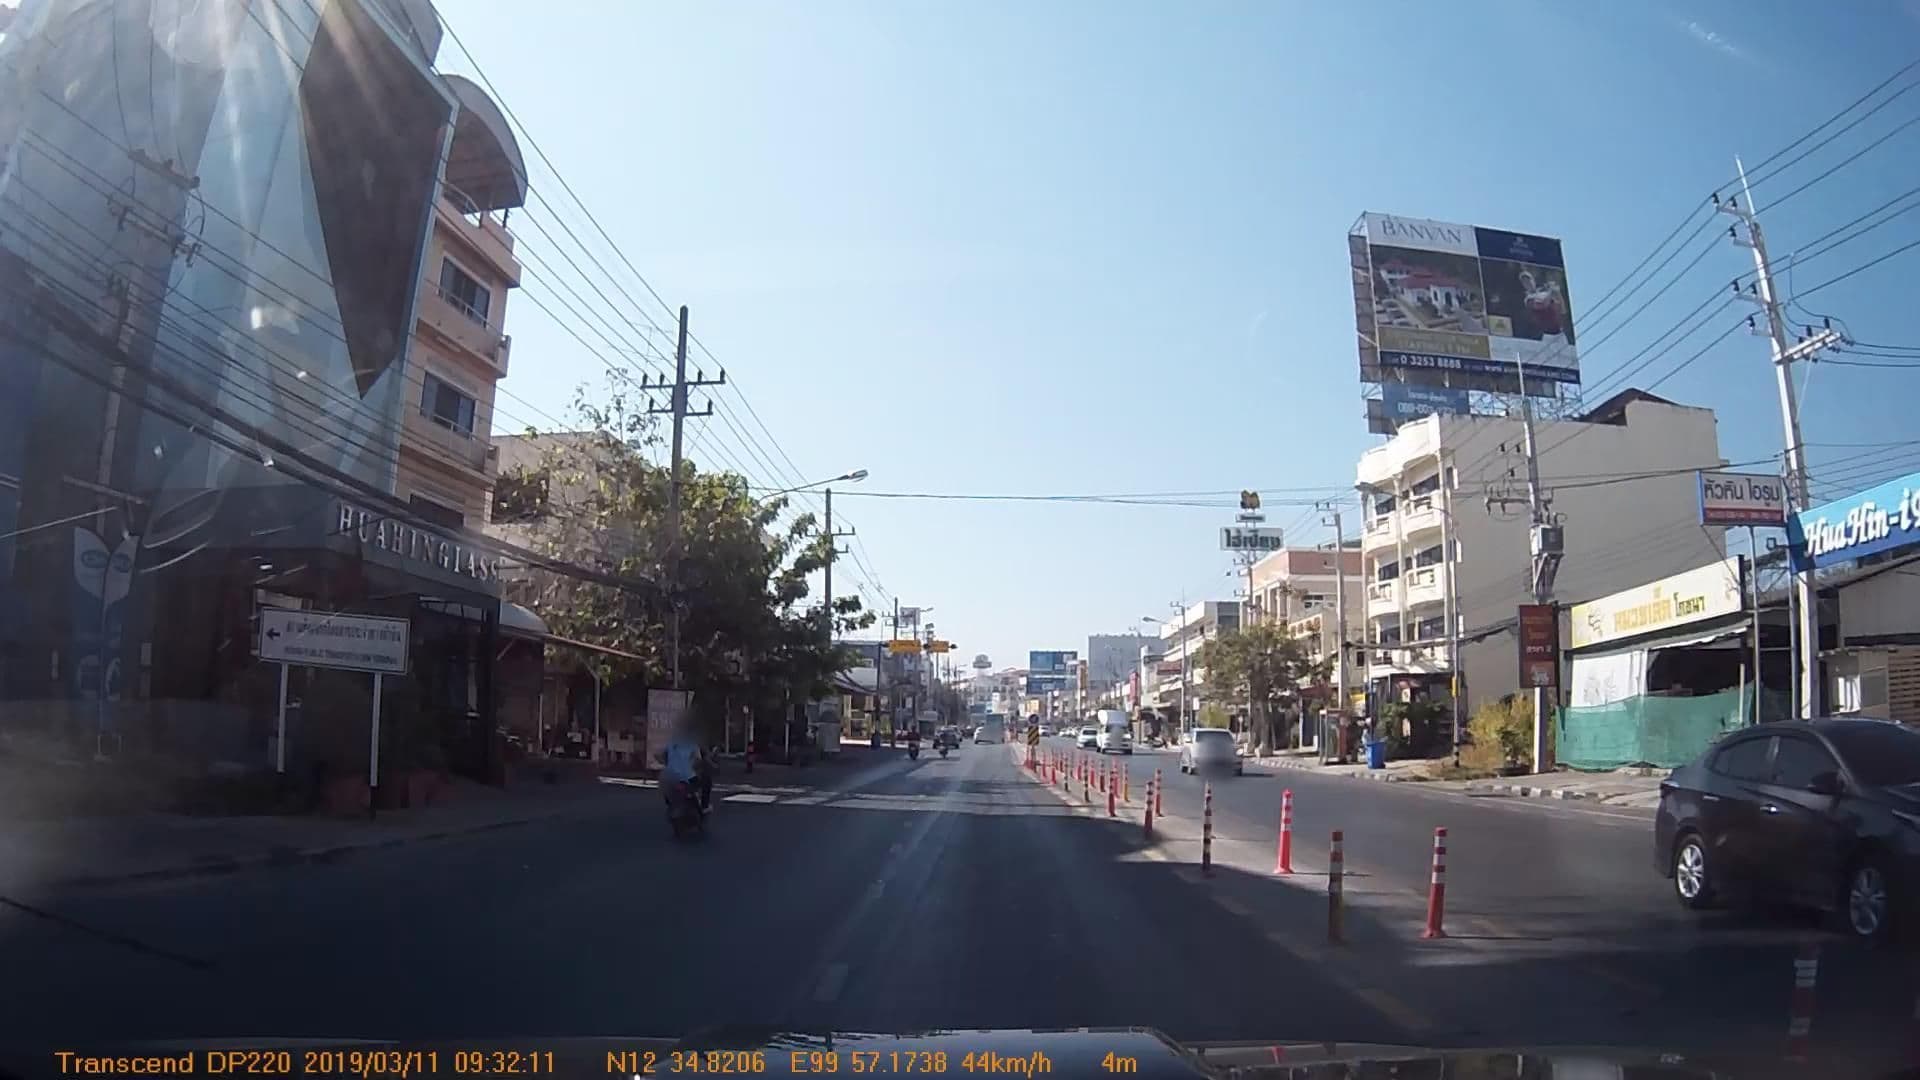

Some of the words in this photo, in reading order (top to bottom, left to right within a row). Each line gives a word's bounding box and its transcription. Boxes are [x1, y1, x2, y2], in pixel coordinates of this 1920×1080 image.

[1400, 354, 1408, 365] 0
[1704, 477, 1744, 501] หัวหิน
[1746, 477, 1780, 507] ไอรูม
